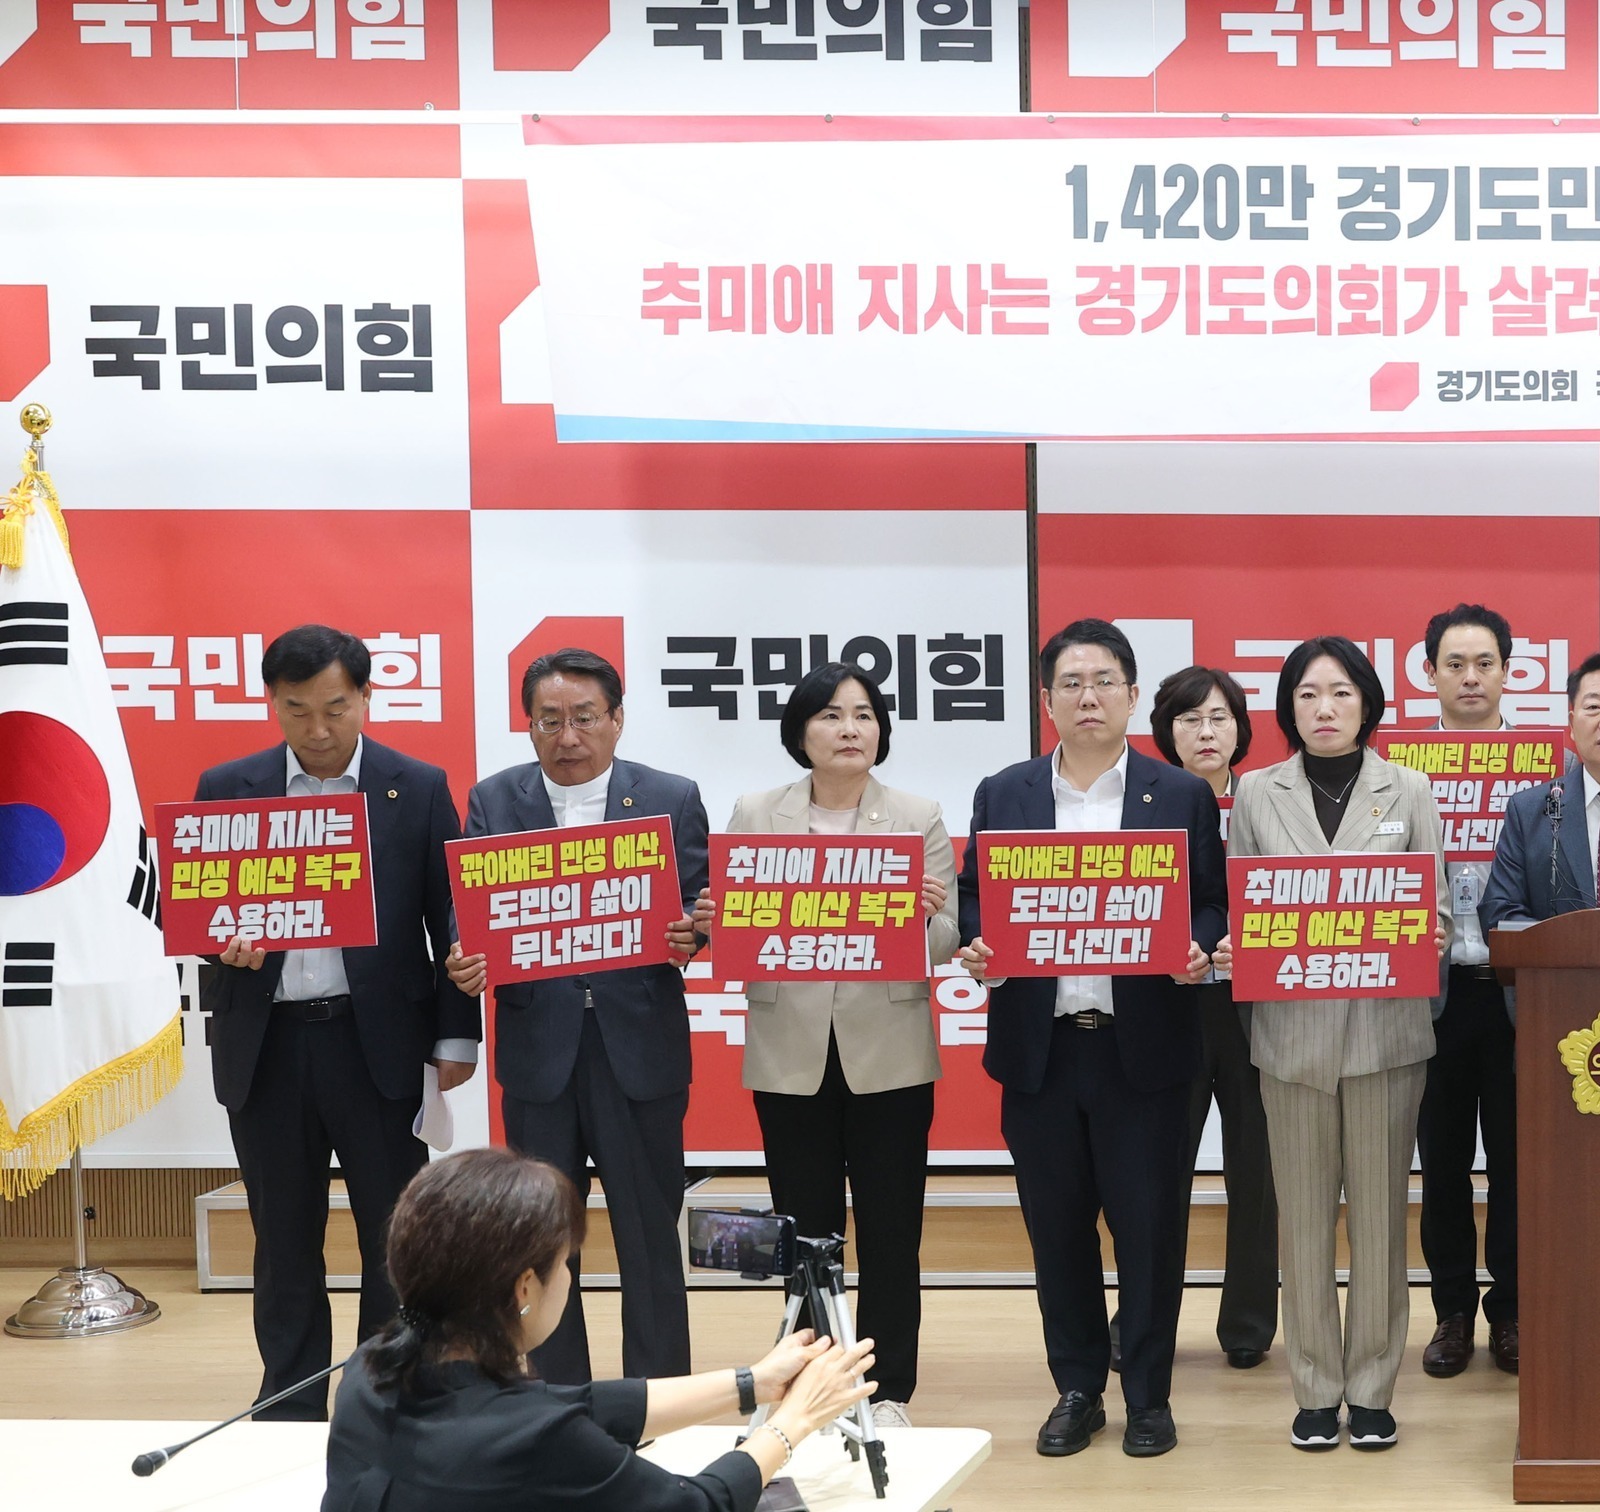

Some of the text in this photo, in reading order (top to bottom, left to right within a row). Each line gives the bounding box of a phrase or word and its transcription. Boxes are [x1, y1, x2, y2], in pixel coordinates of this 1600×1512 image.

[1220, 0, 1566, 70] 국민의힘
[641, 262, 833, 336] 추미애
[857, 263, 1051, 336] 지사는
[1074, 264, 1469, 337] 경기도의회가
[85, 303, 434, 393] 국민의힘
[1436, 369, 1578, 402] 경기도의회
[102, 632, 442, 723] 국민힘
[1468, 742, 1509, 774] 민생
[1512, 742, 1557, 779] 예산,
[1430, 779, 1484, 813] 민의
[172, 808, 353, 854] 추미애 지사는
[171, 852, 361, 900] 민생 예산 복구
[459, 831, 666, 889] 깎아버린 민생 예산,
[726, 845, 911, 884] 추미애 지사는
[988, 844, 1180, 883] 깎아버린 민생 예산,
[488, 873, 651, 930] 도민의 삶이
[1009, 885, 1164, 923] 도민의 삶이
[1244, 867, 1423, 905] 추미애 지사는
[208, 900, 332, 943] 수용하라.
[721, 891, 917, 928] 민생 예산 복구
[1241, 909, 1429, 949] 민생 예산 복구
[511, 918, 642, 970] 무너진다!
[757, 933, 882, 971] 수용하라.
[1026, 927, 1152, 966] 무너진다!
[1275, 951, 1397, 990] 수용하라.
